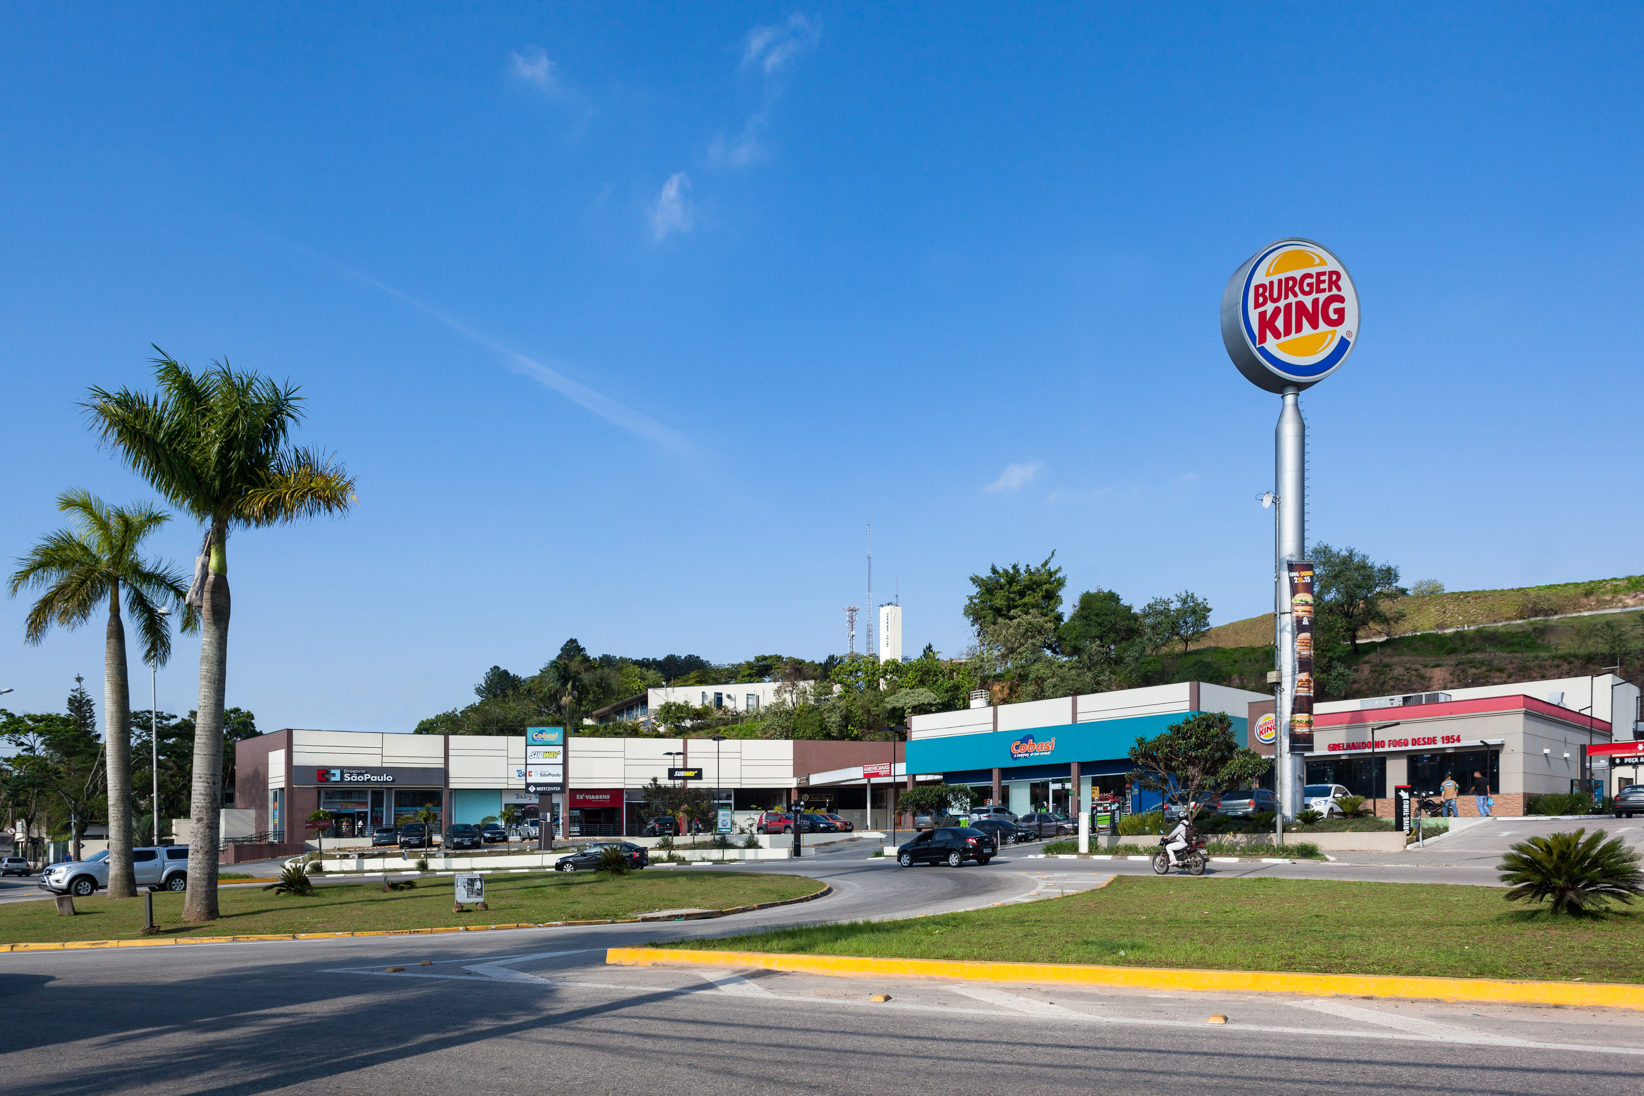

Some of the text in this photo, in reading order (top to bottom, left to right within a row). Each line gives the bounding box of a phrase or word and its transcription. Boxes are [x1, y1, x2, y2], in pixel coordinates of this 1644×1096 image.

[1254, 270, 1342, 310] BURGER
[1257, 293, 1346, 346] KING
[1258, 718, 1275, 731] BURGE
[531, 731, 559, 740] Cobasi
[1327, 734, 1461, 752] GRELHANDO NO FOGO DESDE 1954
[1010, 736, 1056, 754] Cobasi
[528, 750, 561, 760] SUBWAY
[343, 773, 393, 782] SãoPaulo
